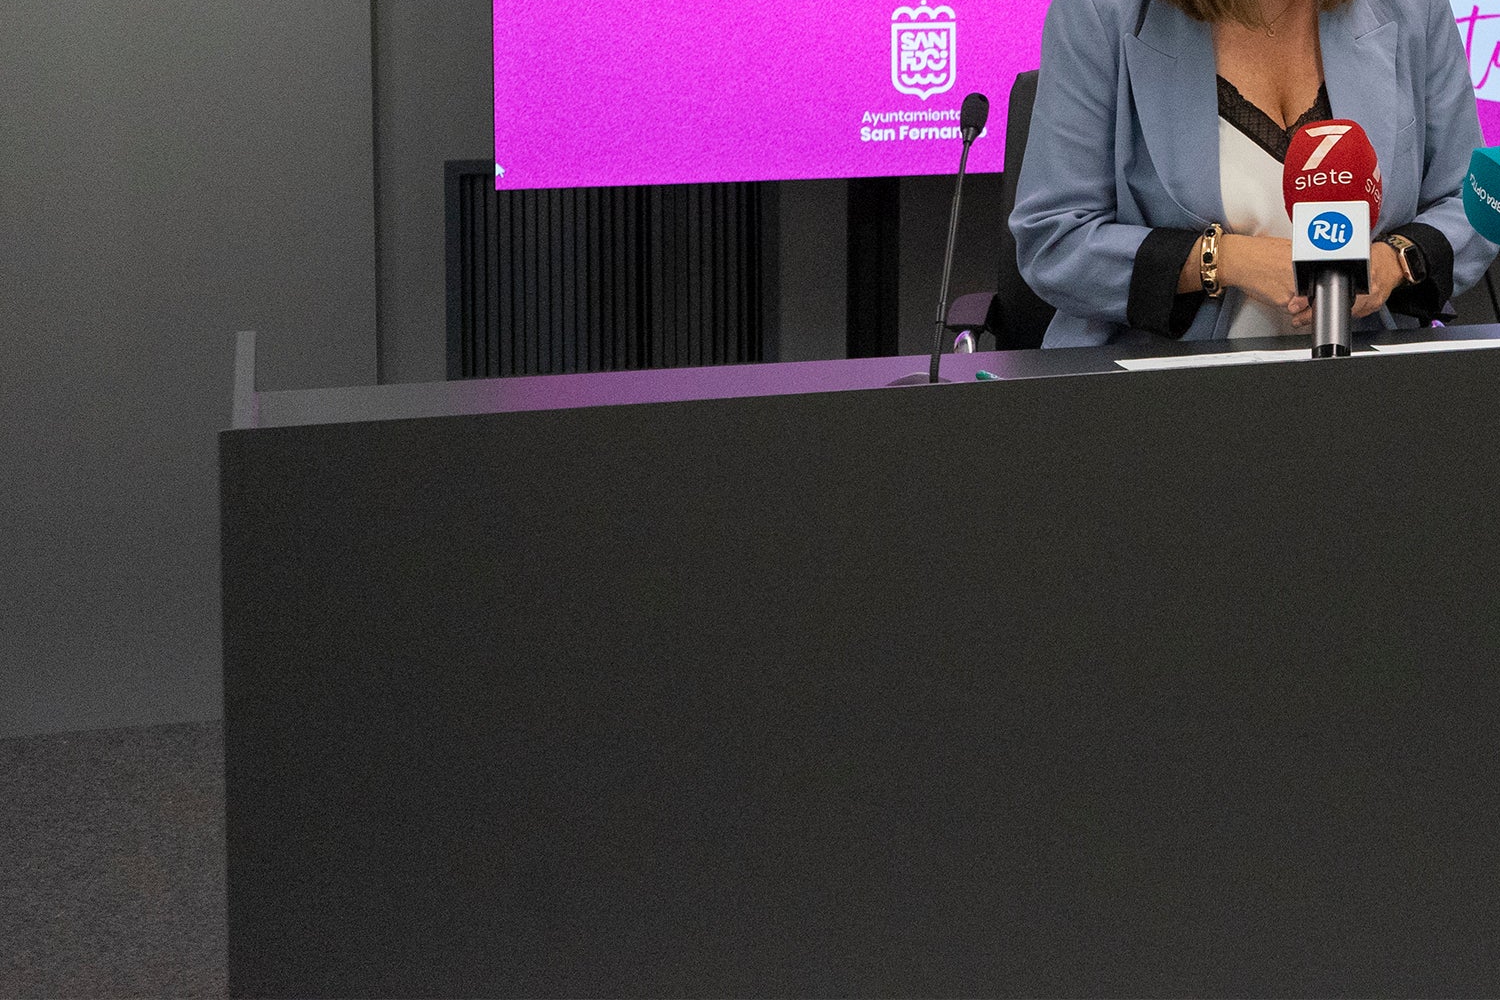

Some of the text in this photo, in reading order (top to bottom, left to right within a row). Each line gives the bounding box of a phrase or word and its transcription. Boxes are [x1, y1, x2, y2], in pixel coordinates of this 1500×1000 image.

[901, 31, 948, 50] SAN
[860, 125, 987, 141] San Fernan
[1301, 125, 1353, 171] 7
